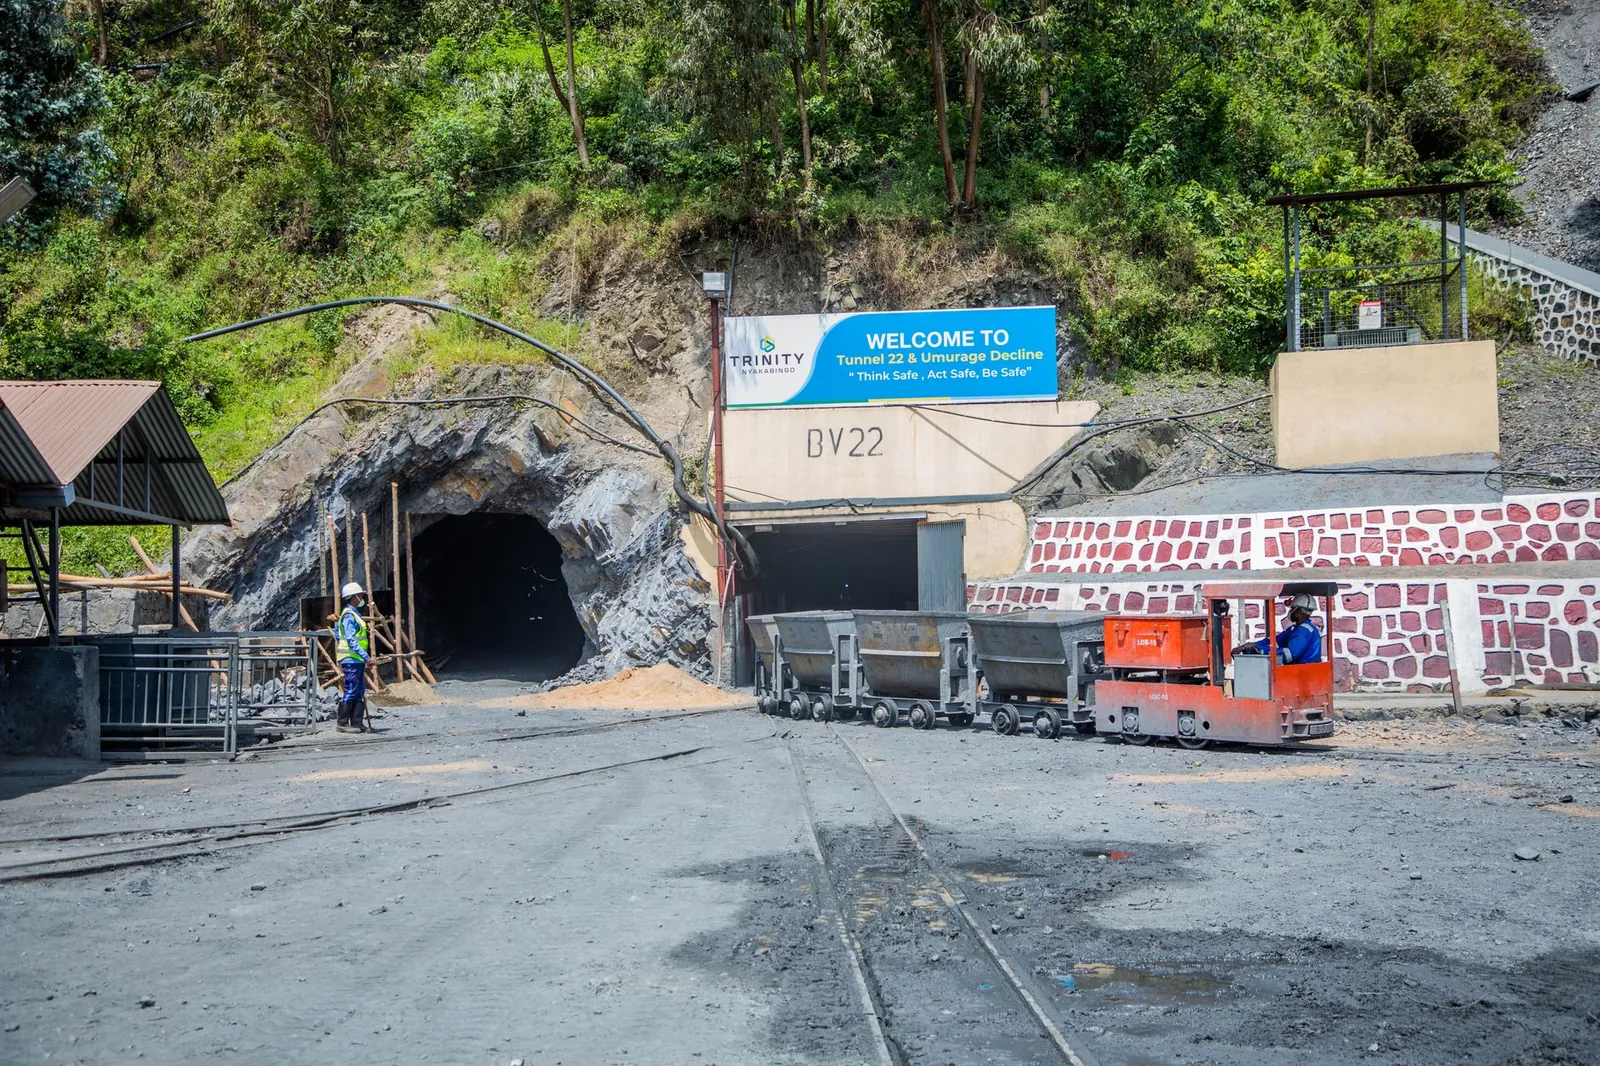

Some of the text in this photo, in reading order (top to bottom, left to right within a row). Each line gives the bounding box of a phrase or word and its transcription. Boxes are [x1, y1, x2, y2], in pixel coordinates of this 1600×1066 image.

[866, 329, 1010, 349] WELCOME TO
[729, 353, 804, 367] TRINITY
[836, 348, 1044, 366] Tunnel 22 & Umurage Decline
[741, 367, 796, 375] NYAKABINGO
[857, 370, 890, 381] Think
[893, 369, 919, 380] Safe
[927, 369, 948, 379] Act
[950, 368, 980, 380] Safe,
[982, 368, 998, 378] Be
[807, 427, 883, 458] BV22
